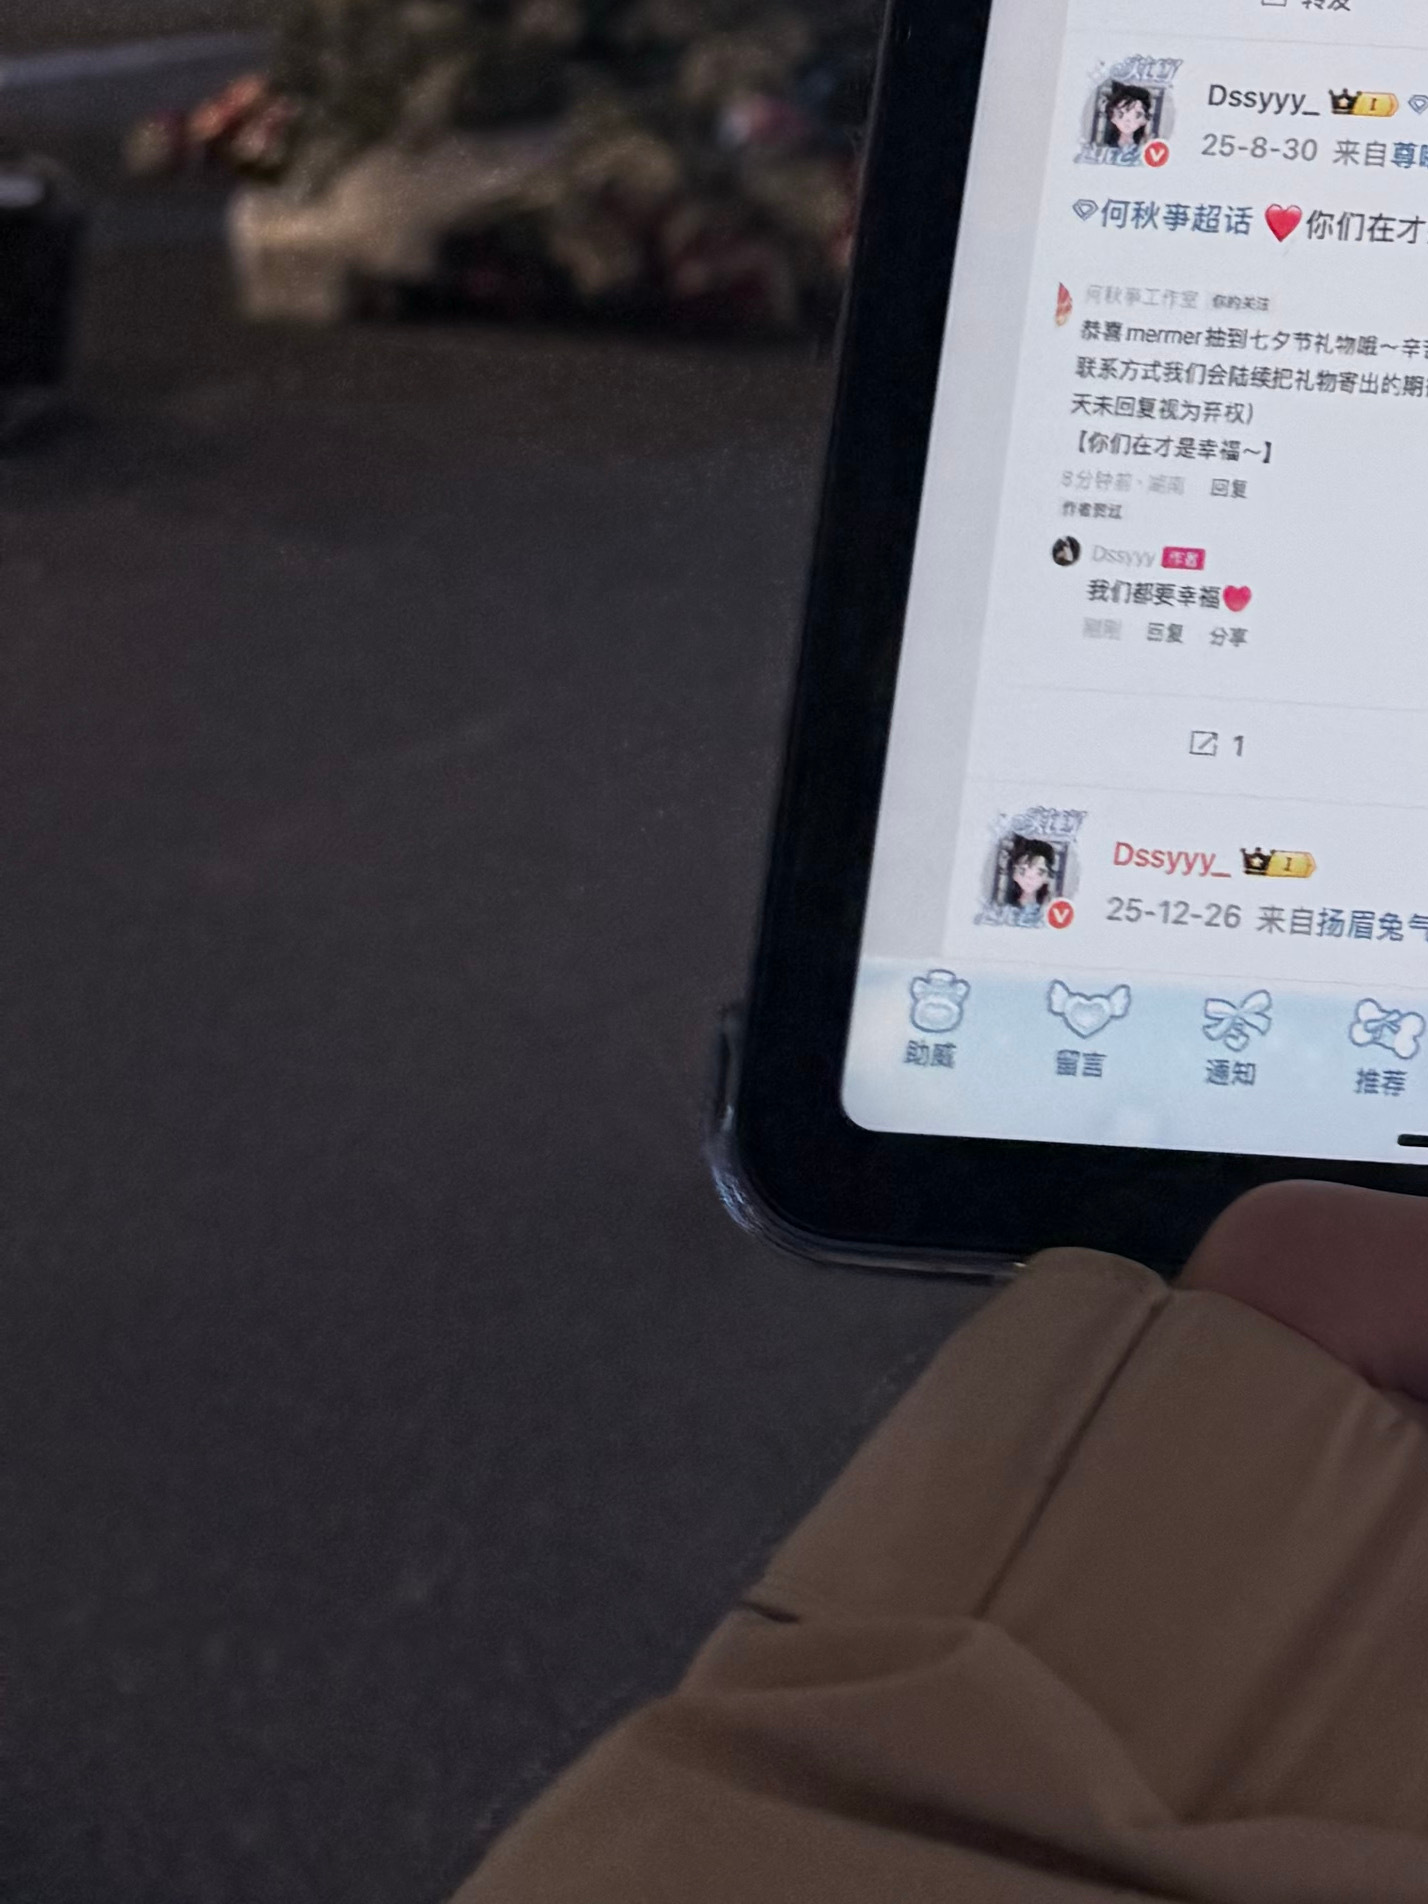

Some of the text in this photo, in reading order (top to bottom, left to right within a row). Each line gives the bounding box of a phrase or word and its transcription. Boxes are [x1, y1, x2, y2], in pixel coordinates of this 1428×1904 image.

[1201, 133, 1318, 163] 25-8-30
[1209, 626, 1249, 648] 分享
[1232, 734, 1246, 757] 1
[1106, 896, 1243, 930] 25-12-26
[1055, 1049, 1107, 1079] 留言
[1205, 1059, 1257, 1088] 通知
[1354, 1069, 1408, 1099] 推荐
